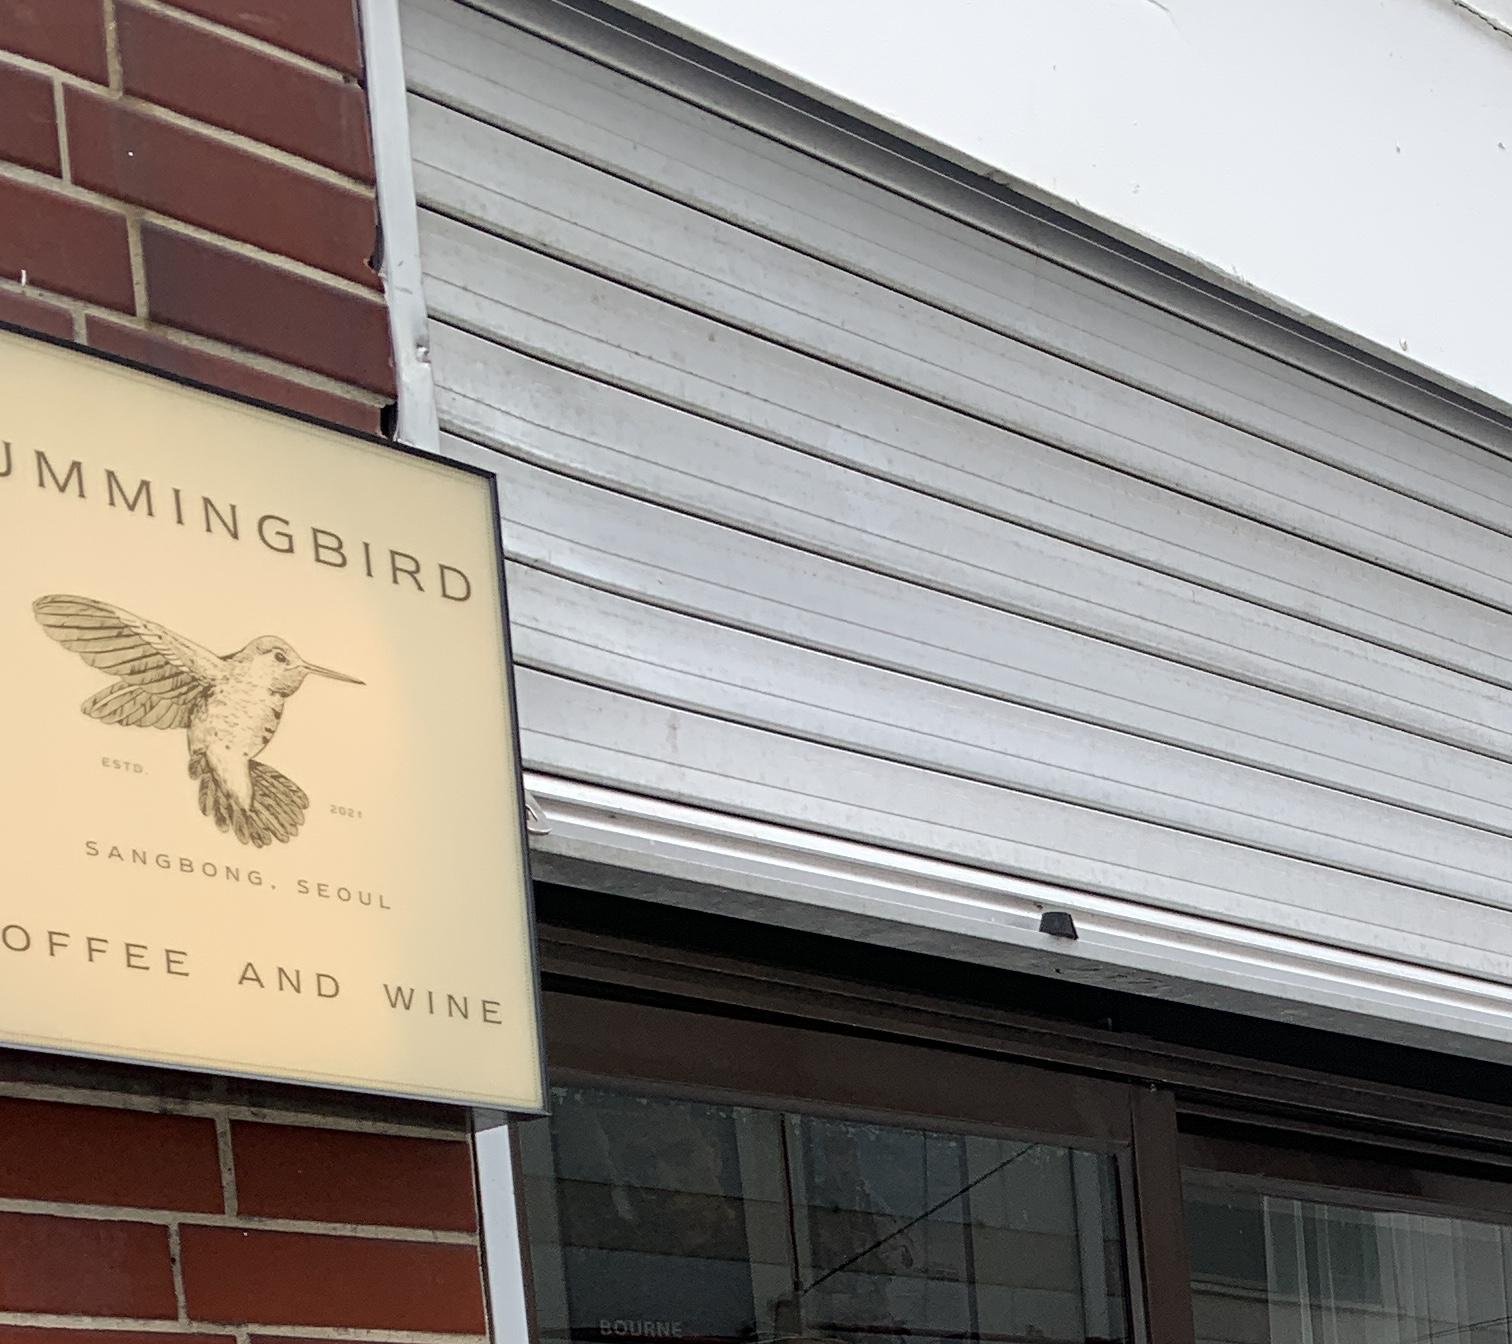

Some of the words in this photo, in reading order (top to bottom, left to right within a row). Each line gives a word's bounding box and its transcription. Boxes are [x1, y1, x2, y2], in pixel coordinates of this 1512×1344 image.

[297, 879, 392, 910] SEOUL
[238, 961, 341, 998] AND
[383, 983, 503, 1025] WINE
[600, 1319, 682, 1338] BOURNE
